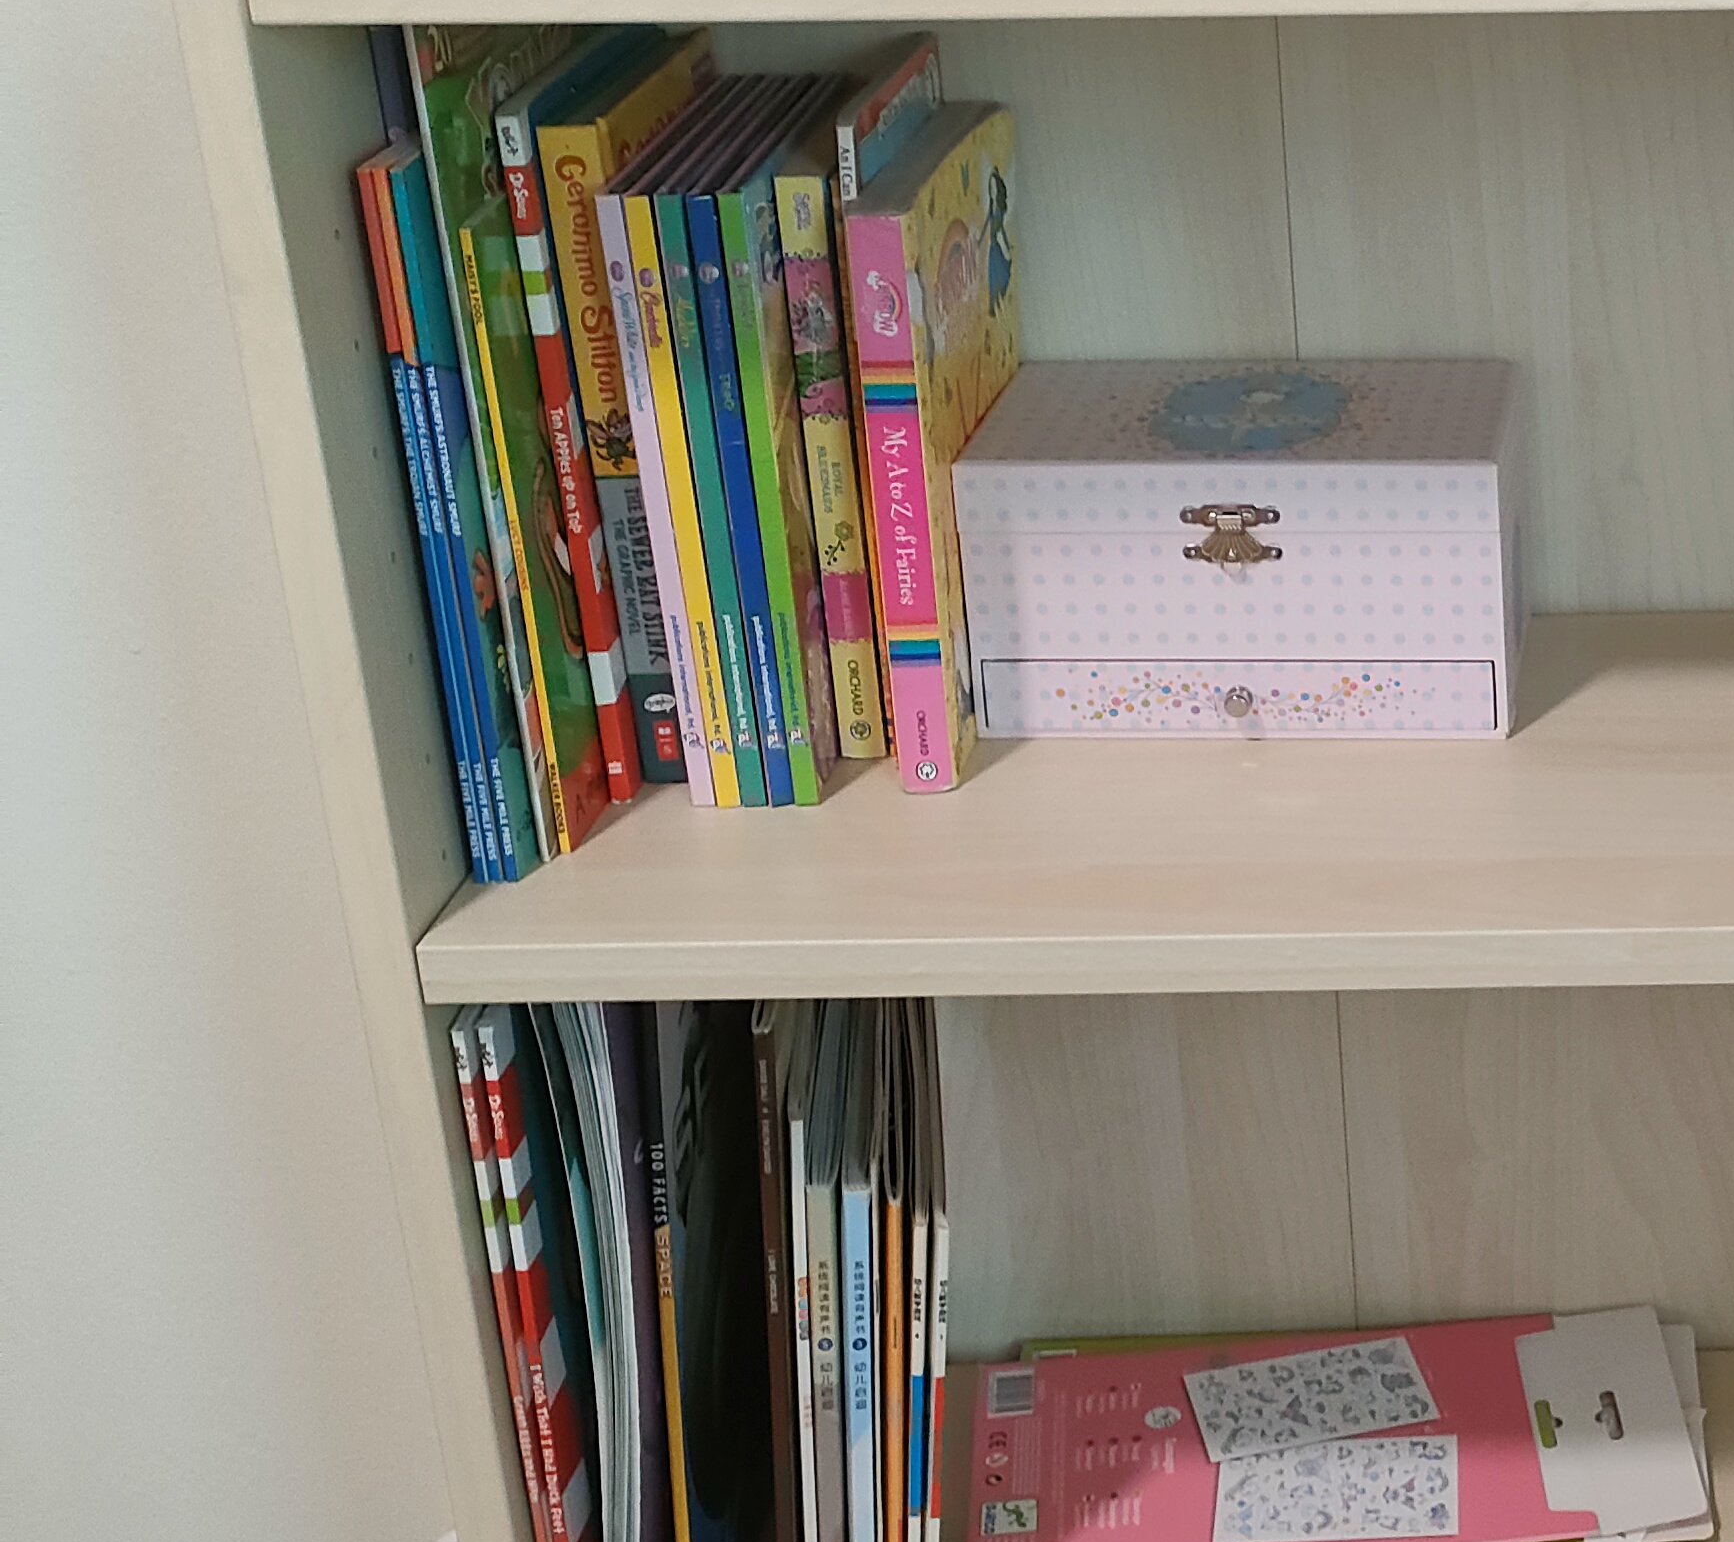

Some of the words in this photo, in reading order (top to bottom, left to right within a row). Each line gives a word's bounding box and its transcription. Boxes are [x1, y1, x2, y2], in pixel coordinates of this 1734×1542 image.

[554, 153, 598, 297] Geronimo
[580, 304, 617, 403] Stilton
[882, 426, 909, 458] My
[886, 461, 906, 480] A
[889, 481, 906, 500] to
[890, 502, 913, 525] Z
[894, 524, 914, 546] of
[896, 546, 917, 606] Fairies
[847, 659, 864, 716] ORCHARD
[916, 710, 929, 756] ORCHARD
[650, 1143, 664, 1171] 100
[652, 1175, 668, 1224] FACTS
[656, 1234, 672, 1297] SPACE
